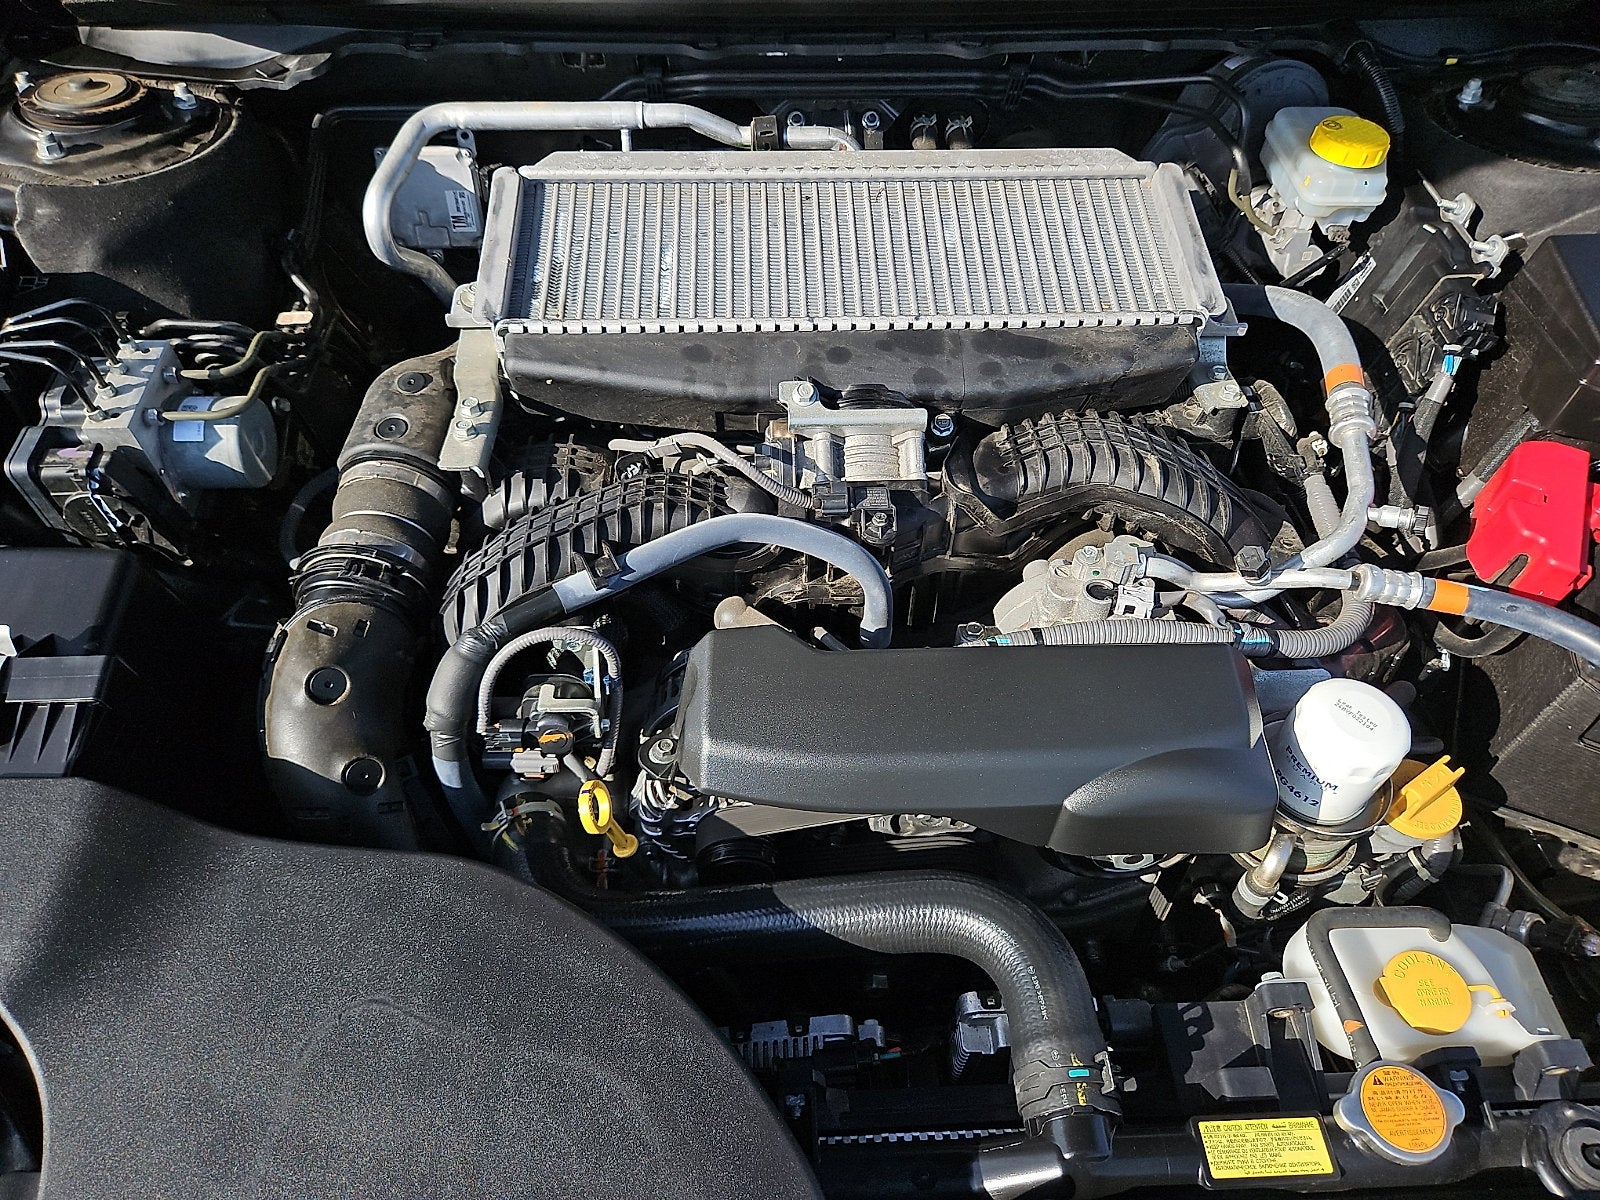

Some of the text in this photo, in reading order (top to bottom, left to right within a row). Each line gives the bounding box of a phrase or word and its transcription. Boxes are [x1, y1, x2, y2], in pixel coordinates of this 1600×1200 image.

[1356, 710, 1378, 728] Tested
[1285, 745, 1338, 790] PREMIUM
[1275, 768, 1320, 806] PG4612
